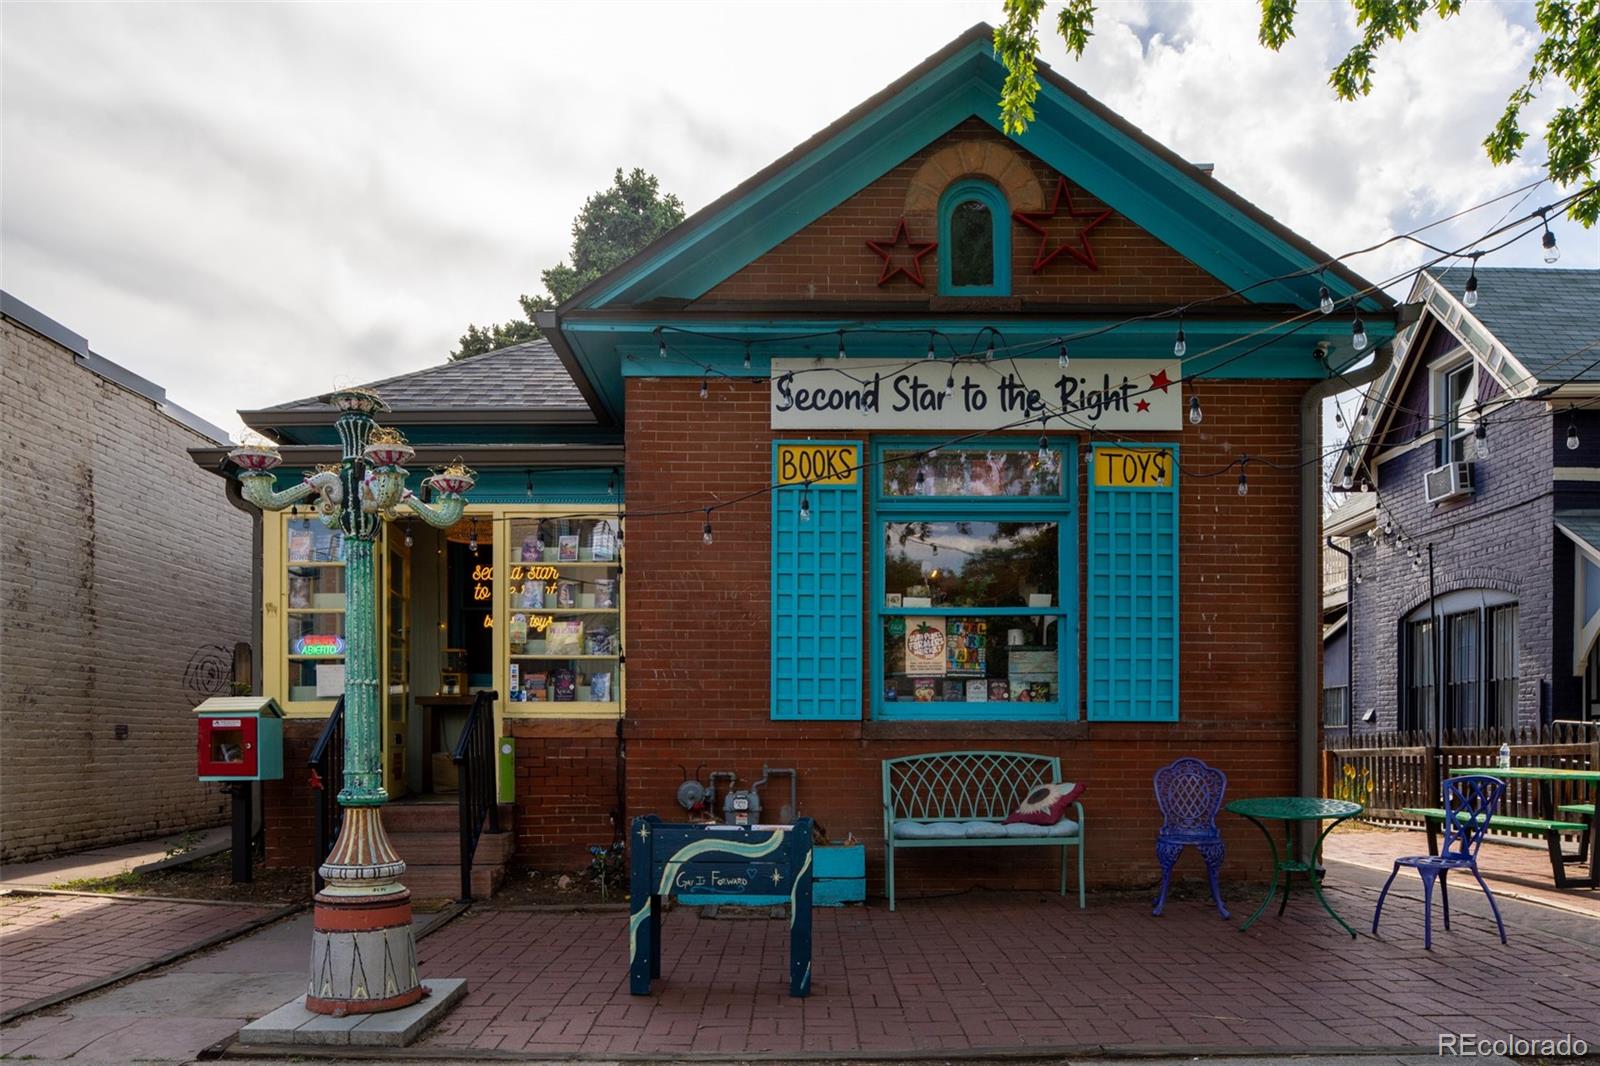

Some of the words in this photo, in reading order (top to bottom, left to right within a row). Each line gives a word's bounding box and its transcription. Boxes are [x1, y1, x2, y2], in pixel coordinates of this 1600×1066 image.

[776, 371, 880, 412] Second
[892, 375, 947, 412] Star
[961, 375, 988, 412] to
[997, 373, 1046, 412] the
[1054, 373, 1139, 420] Right
[782, 449, 852, 480] BOOKS
[1100, 451, 1166, 484] TOYS
[527, 565, 560, 580] star
[474, 582, 491, 600] to
